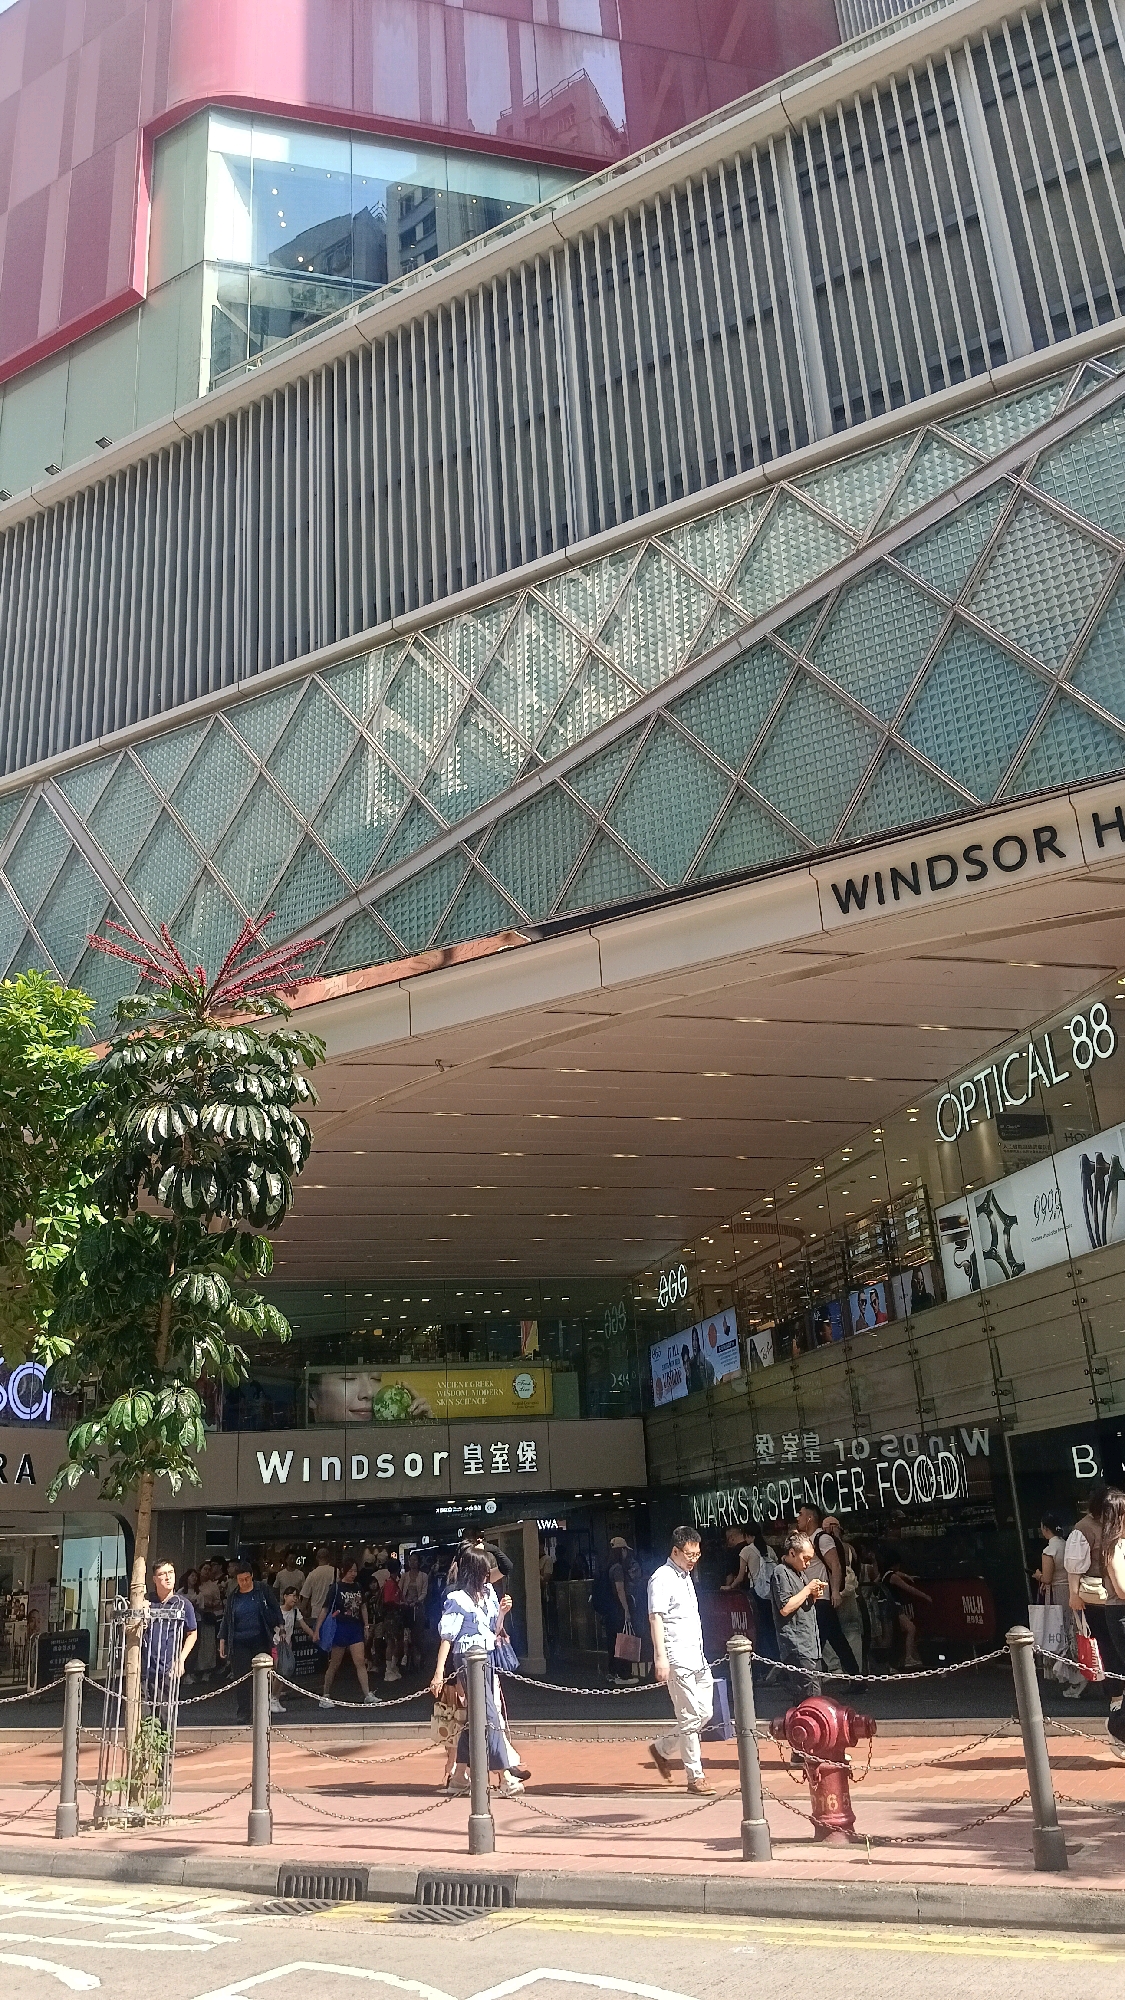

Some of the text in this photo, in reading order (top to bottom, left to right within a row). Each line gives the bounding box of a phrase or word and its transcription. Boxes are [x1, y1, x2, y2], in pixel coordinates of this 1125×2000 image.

[831, 825, 1067, 914] WINDSOR
[936, 1001, 1117, 1143] OPTICAL 88
[469, 1380, 494, 1388] GREEK
[471, 1388, 504, 1396] MODERN
[436, 1397, 488, 1406] SKIN SCIENCE
[463, 1440, 539, 1476] 皇室堡
[693, 1451, 960, 1529] MARKS & SPENCER FOOD
[961, 1595, 985, 1614] MUJI
